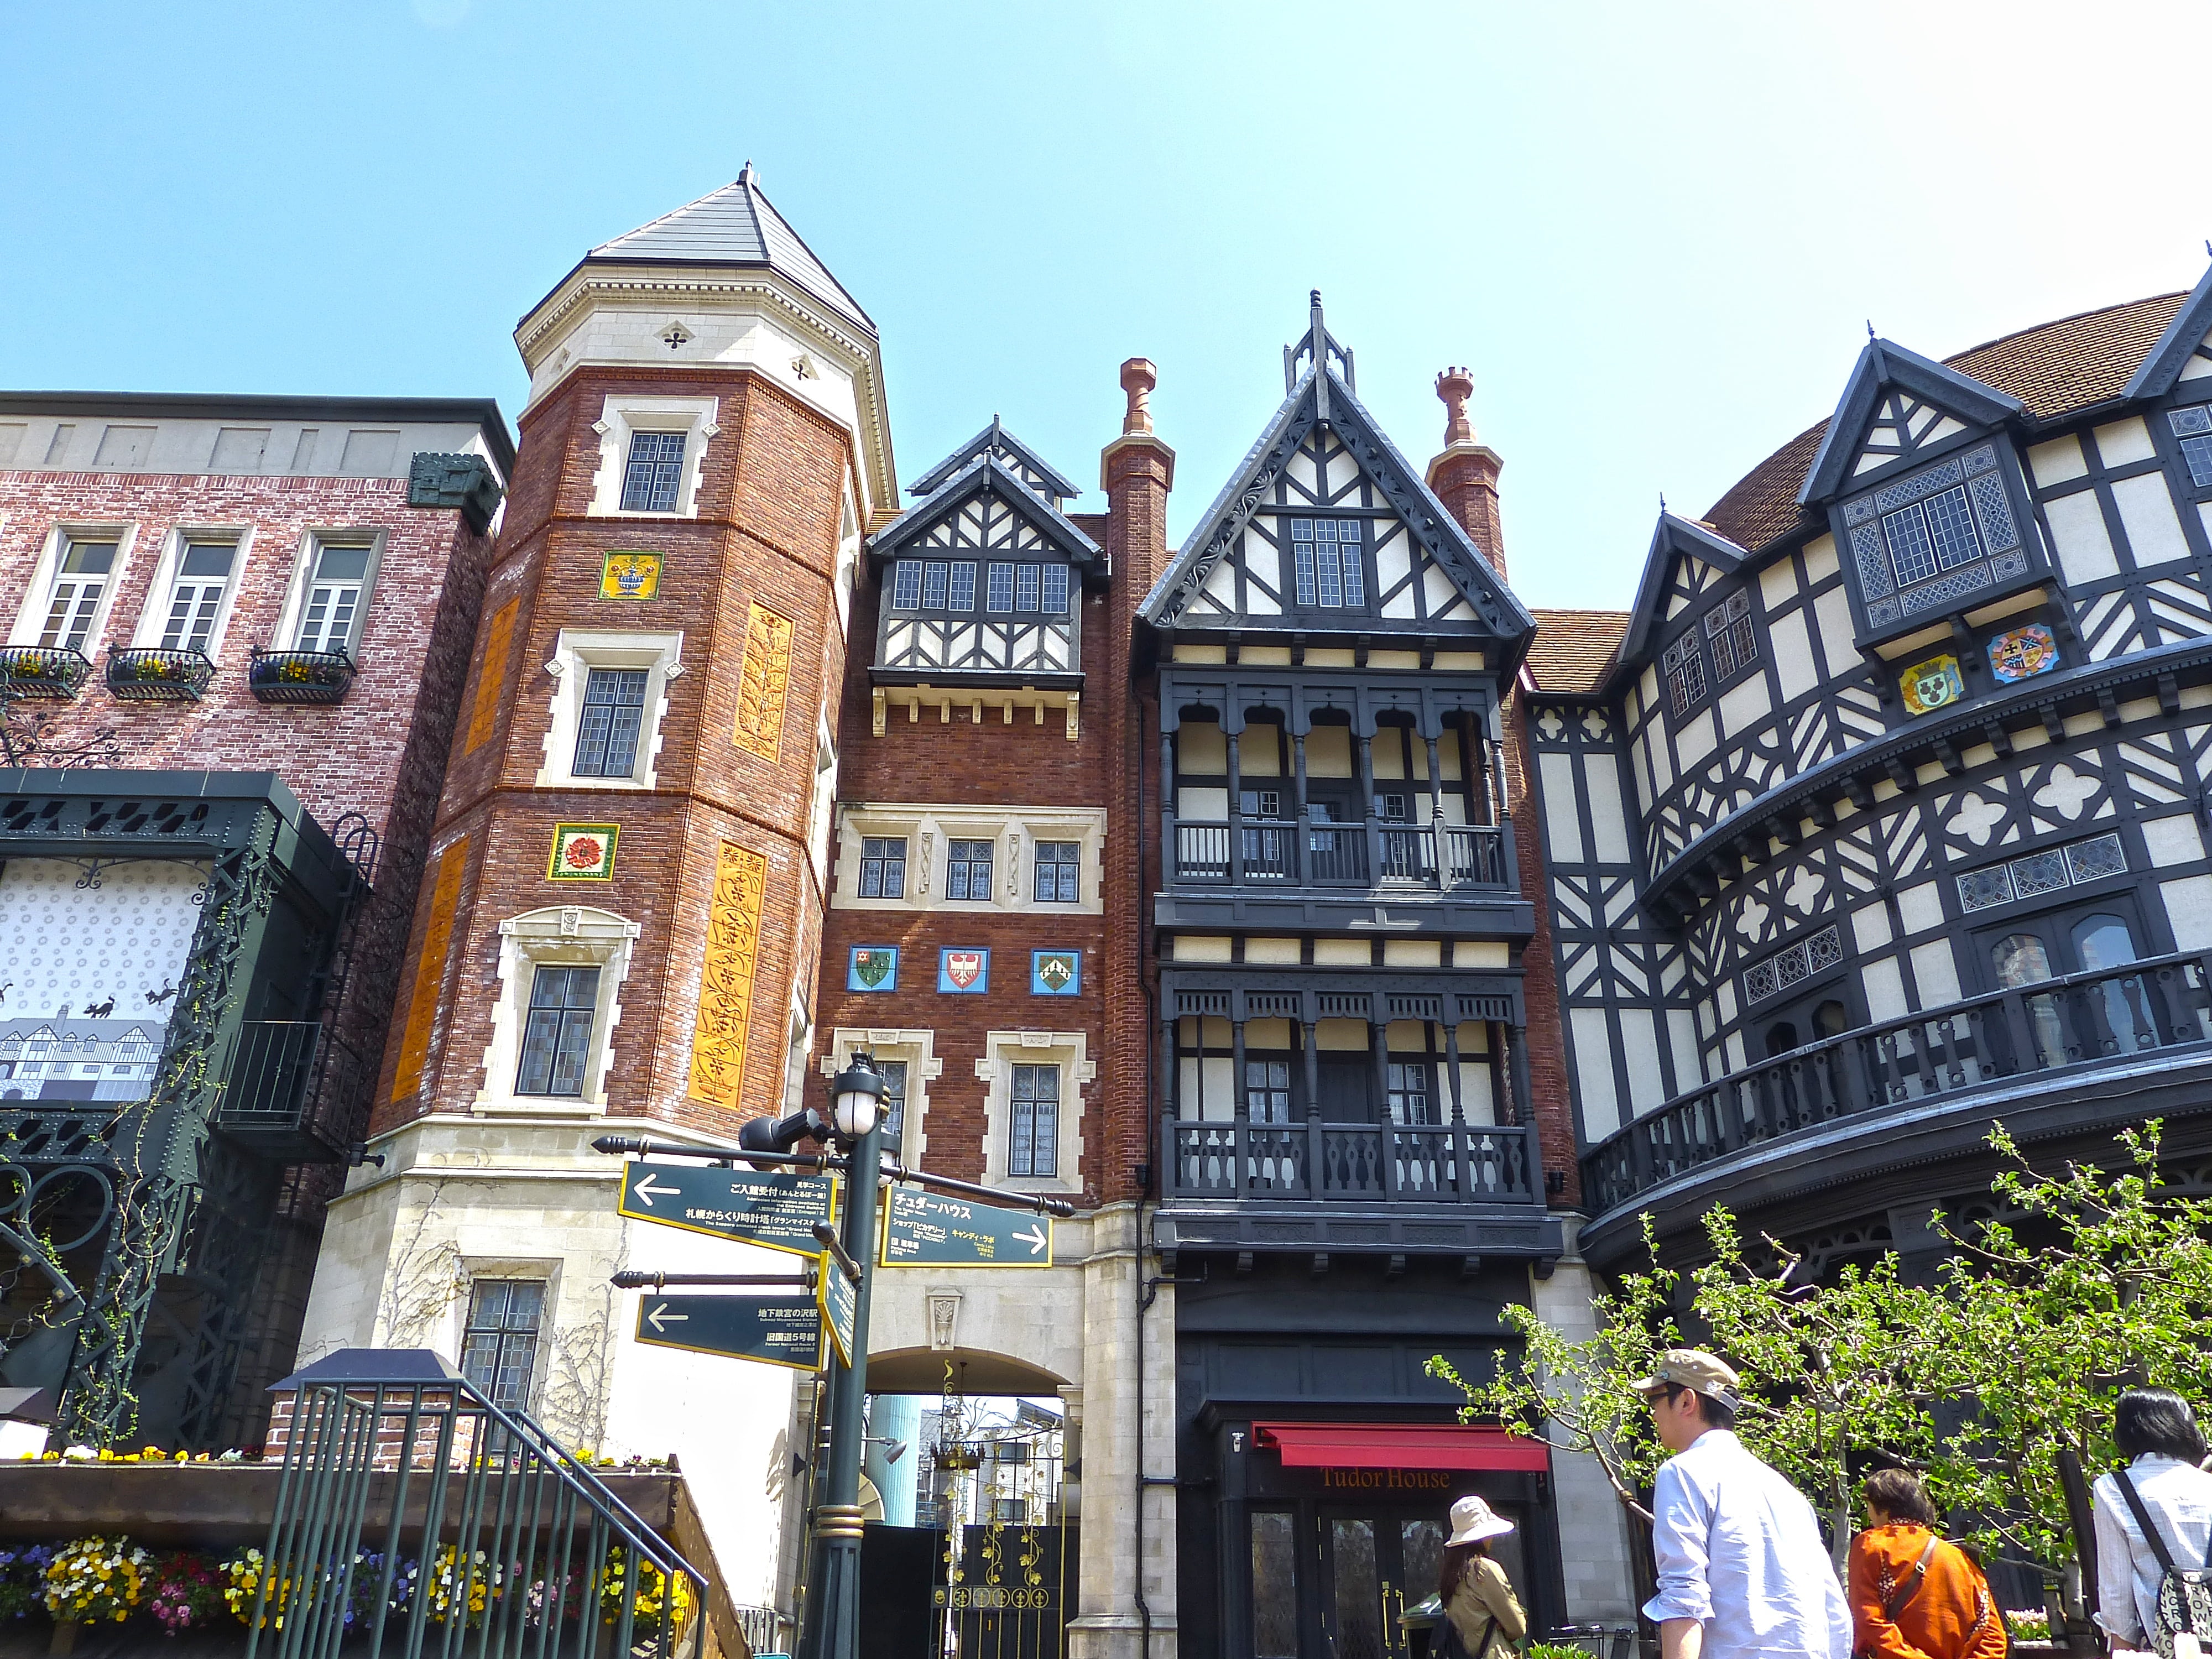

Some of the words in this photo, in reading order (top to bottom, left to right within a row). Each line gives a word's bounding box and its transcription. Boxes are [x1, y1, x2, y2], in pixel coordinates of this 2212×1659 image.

[894, 1193, 972, 1219] チュダーハウス
[766, 1332, 816, 1342] 旧国道5号線
[1320, 1466, 1383, 1488] Tudor
[1387, 1467, 1450, 1489] House
